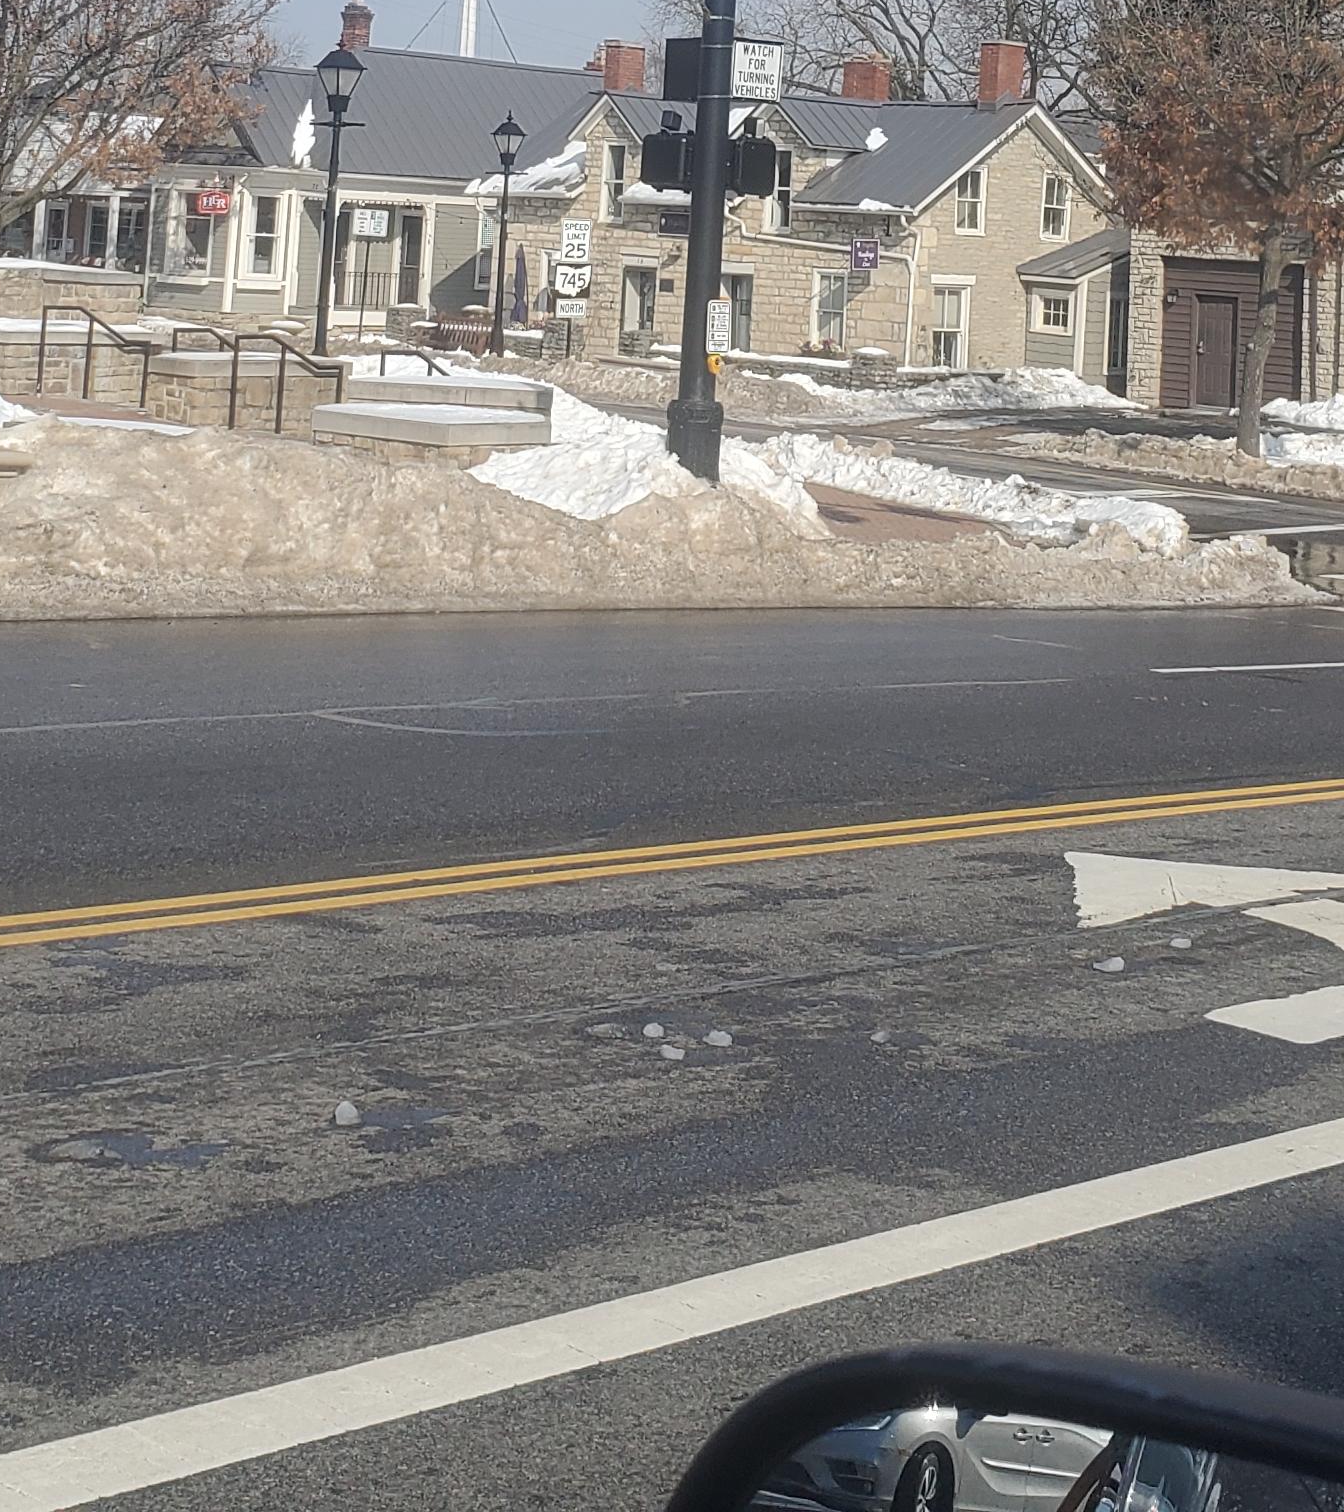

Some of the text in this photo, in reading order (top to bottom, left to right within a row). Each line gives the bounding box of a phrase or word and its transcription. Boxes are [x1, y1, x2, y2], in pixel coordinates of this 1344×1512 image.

[743, 44, 774, 58] WATCH
[748, 58, 766, 71] FOR
[737, 70, 775, 86] TURNING
[735, 84, 776, 99] VEHICLES
[564, 223, 590, 231] SPEED
[567, 232, 587, 241] LIMIT
[564, 243, 587, 259] 25
[559, 273, 587, 289] 745
[559, 303, 584, 314] NORTH
